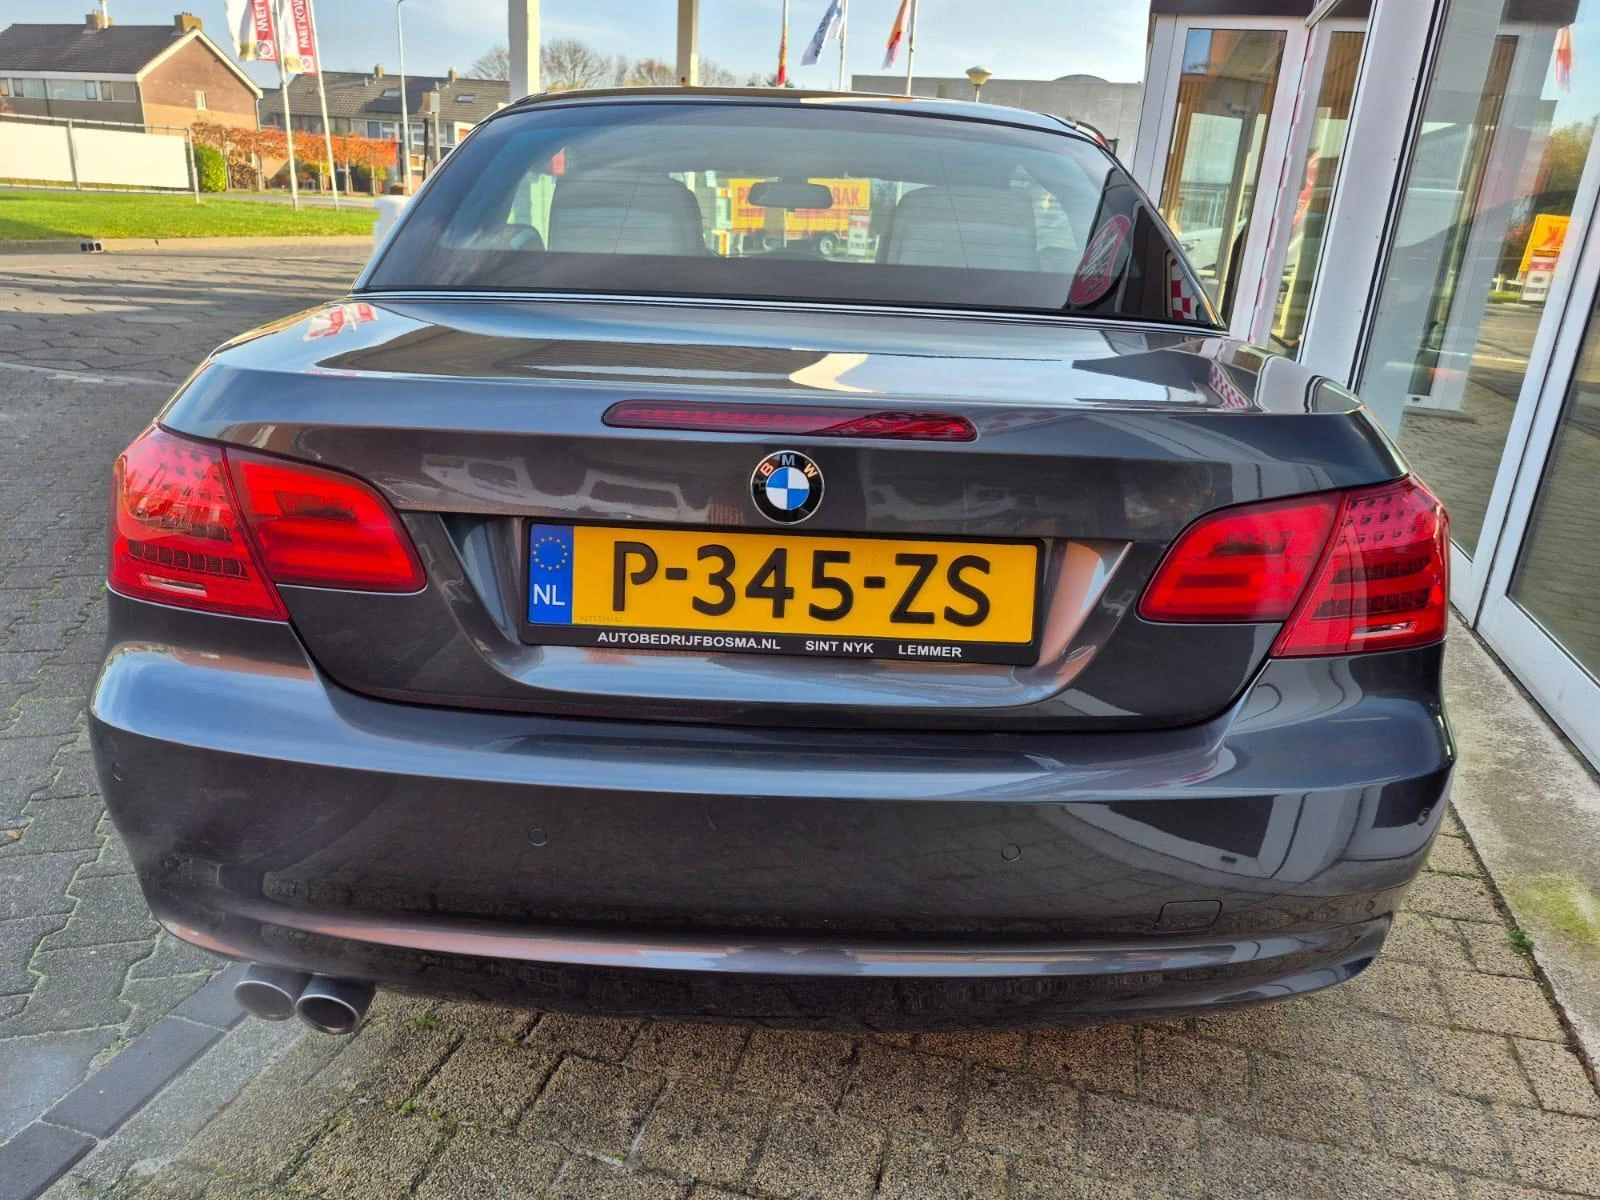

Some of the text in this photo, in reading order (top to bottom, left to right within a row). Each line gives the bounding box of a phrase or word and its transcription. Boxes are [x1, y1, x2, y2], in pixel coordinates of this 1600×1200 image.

[760, 454, 818, 478] BMW
[533, 583, 566, 606] NL
[612, 540, 991, 627] P-345-ZS
[597, 631, 963, 658] AUTOBEDRIJFBOSMA.NL SINT NYK LEMMER
